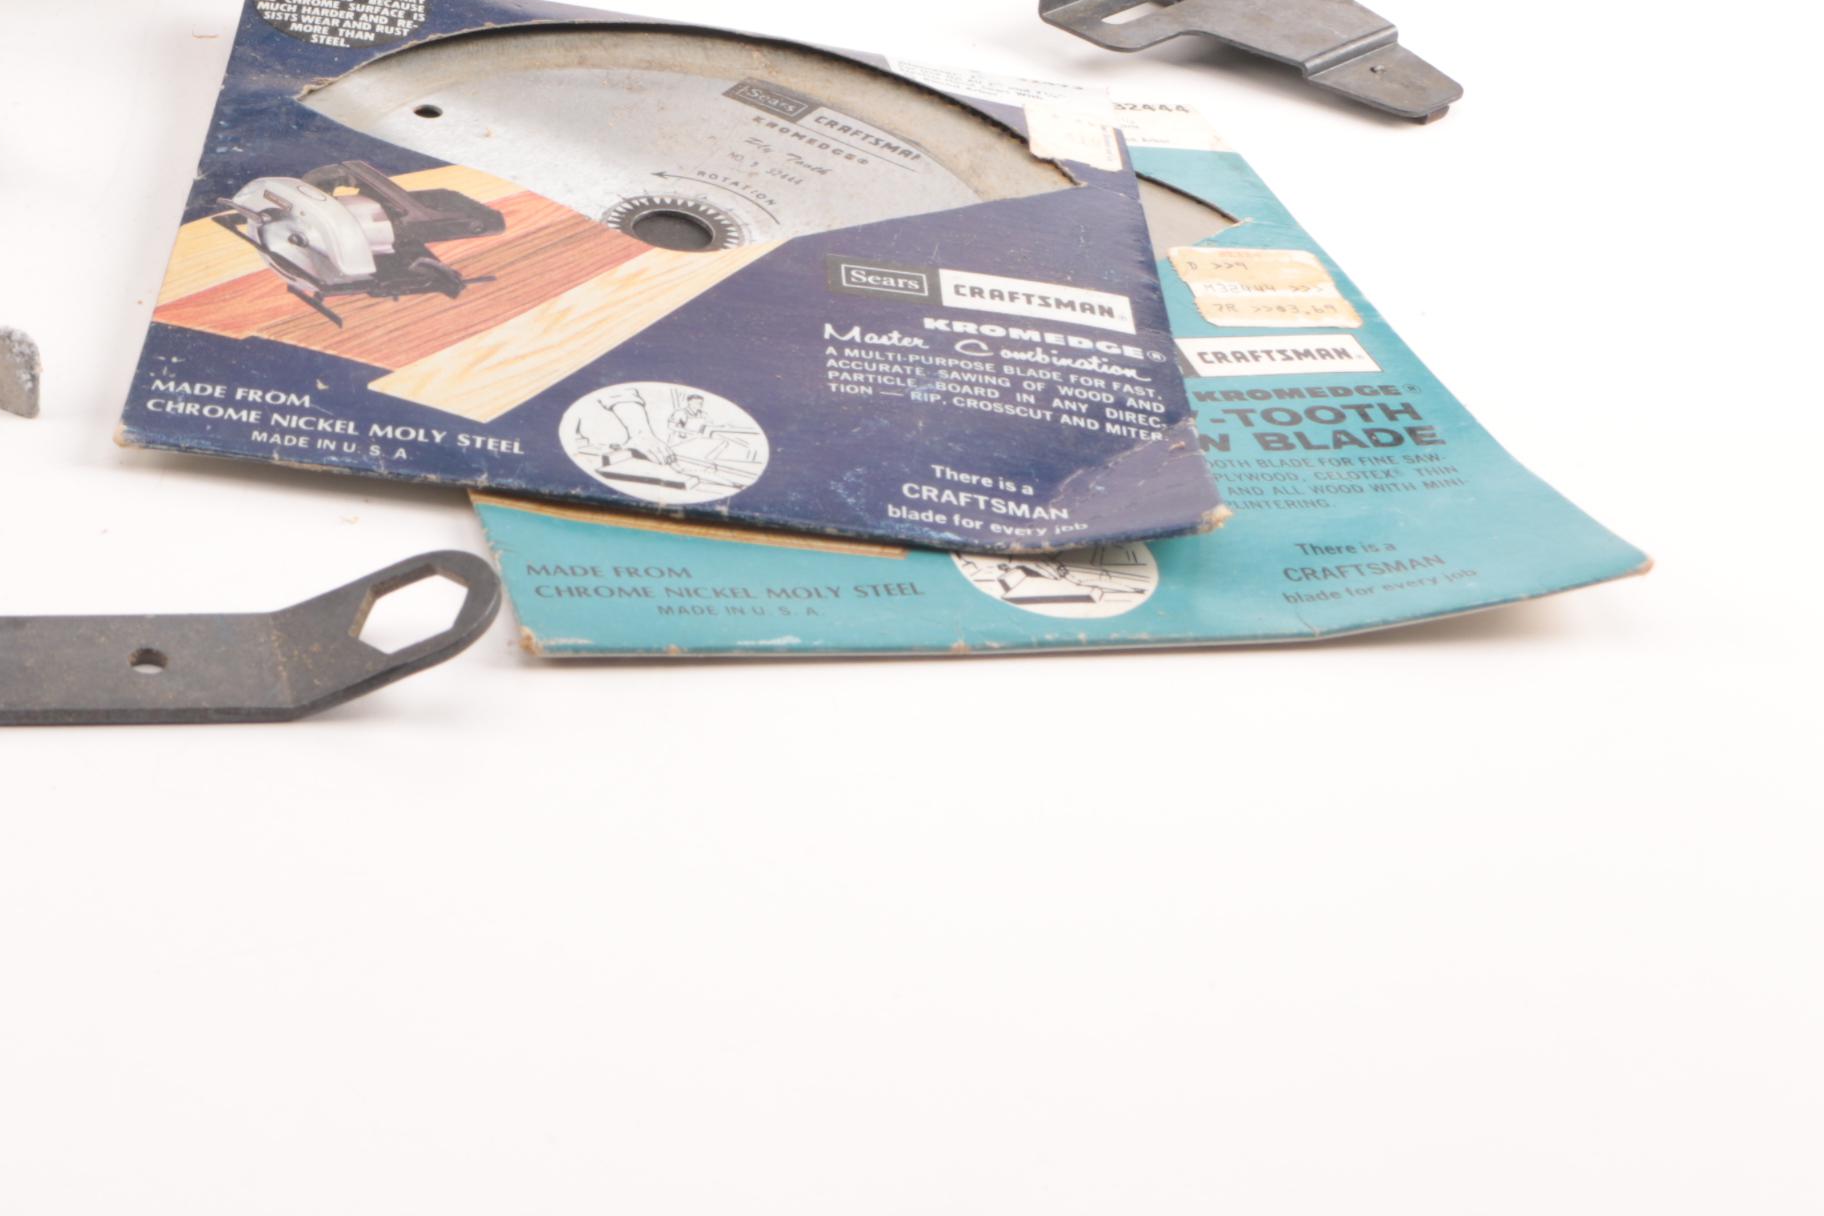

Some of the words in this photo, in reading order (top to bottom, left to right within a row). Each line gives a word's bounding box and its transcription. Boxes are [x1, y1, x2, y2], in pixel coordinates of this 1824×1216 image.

[257, 1, 297, 13] MUCH
[301, 5, 354, 20] HARDER
[359, 13, 388, 25] AND
[397, 19, 418, 29] RE-
[264, 11, 298, 22] SISTS
[301, 15, 340, 27] WEAR
[342, 20, 372, 31] AND
[376, 24, 410, 37] RUST
[348, 3, 405, 18] SURFACE
[413, 13, 425, 22] IS
[290, 23, 329, 35] MORE
[338, 28, 375, 41] THAN
[311, 34, 350, 48] STEEL.
[746, 85, 798, 114] Sears
[696, 169, 777, 207] ROTATION
[850, 268, 920, 292] Sears
[953, 283, 1114, 319] CRAFTSMAN
[824, 323, 930, 349] Master
[954, 339, 1152, 382] Combination
[1196, 347, 1353, 365] CRAFTSMAN
[826, 346, 837, 356] A
[845, 348, 996, 372] MULTI-PURPOSE
[1003, 365, 1063, 382] BLADE
[1070, 374, 1106, 389] FOR
[151, 379, 226, 399] MADE
[234, 387, 312, 408] FROM
[826, 359, 926, 376] ACCURATE
[938, 369, 1011, 387] SAWING
[1022, 381, 1045, 392] OF
[1058, 385, 1114, 404] WOOD
[1126, 397, 1165, 413] AND
[828, 370, 917, 387] PARTICLE
[935, 381, 999, 399] BOARD
[1016, 393, 1035, 404] IN
[1052, 398, 1088, 413] ANY
[828, 383, 873, 395] TION
[952, 396, 1053, 421] CROSSCUT
[1060, 415, 1100, 430] AND
[146, 399, 261, 424] CHROME
[270, 413, 359, 436] NICKEL
[369, 424, 447, 445] MOLY
[456, 434, 525, 455] STEEL
[251, 430, 309, 448] MADE
[317, 437, 336, 450] IN
[1252, 425, 1447, 452] BLADE
[1257, 458, 1315, 468] BLADE
[1318, 456, 1353, 467] FOR
[1358, 455, 1398, 466] FINE
[1414, 465, 1458, 477] THIN
[931, 464, 993, 488] There
[998, 476, 1016, 492] is
[1021, 484, 1034, 496] a
[1227, 486, 1264, 496] AND
[1272, 485, 1304, 496] ALL
[1310, 484, 1365, 495] WOOD
[1368, 482, 1417, 494] WITH
[902, 483, 1069, 520] CRAFTSMAN
[887, 504, 947, 524] blade
[953, 515, 984, 529] for
[989, 522, 1047, 536] every
[1054, 522, 1088, 534] job
[1295, 542, 1357, 555] There
[1361, 542, 1380, 553] is
[1384, 542, 1397, 552] a
[526, 564, 604, 578] MADE
[613, 566, 693, 580] FROM
[1283, 554, 1446, 582] CRAFTSMAN
[534, 585, 654, 599] CHROME
[664, 585, 758, 600] NICKEL
[766, 585, 842, 600] MOLY
[852, 582, 926, 598] STEEL
[1282, 590, 1341, 604] blade
[1345, 585, 1376, 597] for
[1382, 576, 1440, 592] every
[656, 604, 718, 617] MADE
[725, 604, 745, 617] IN
